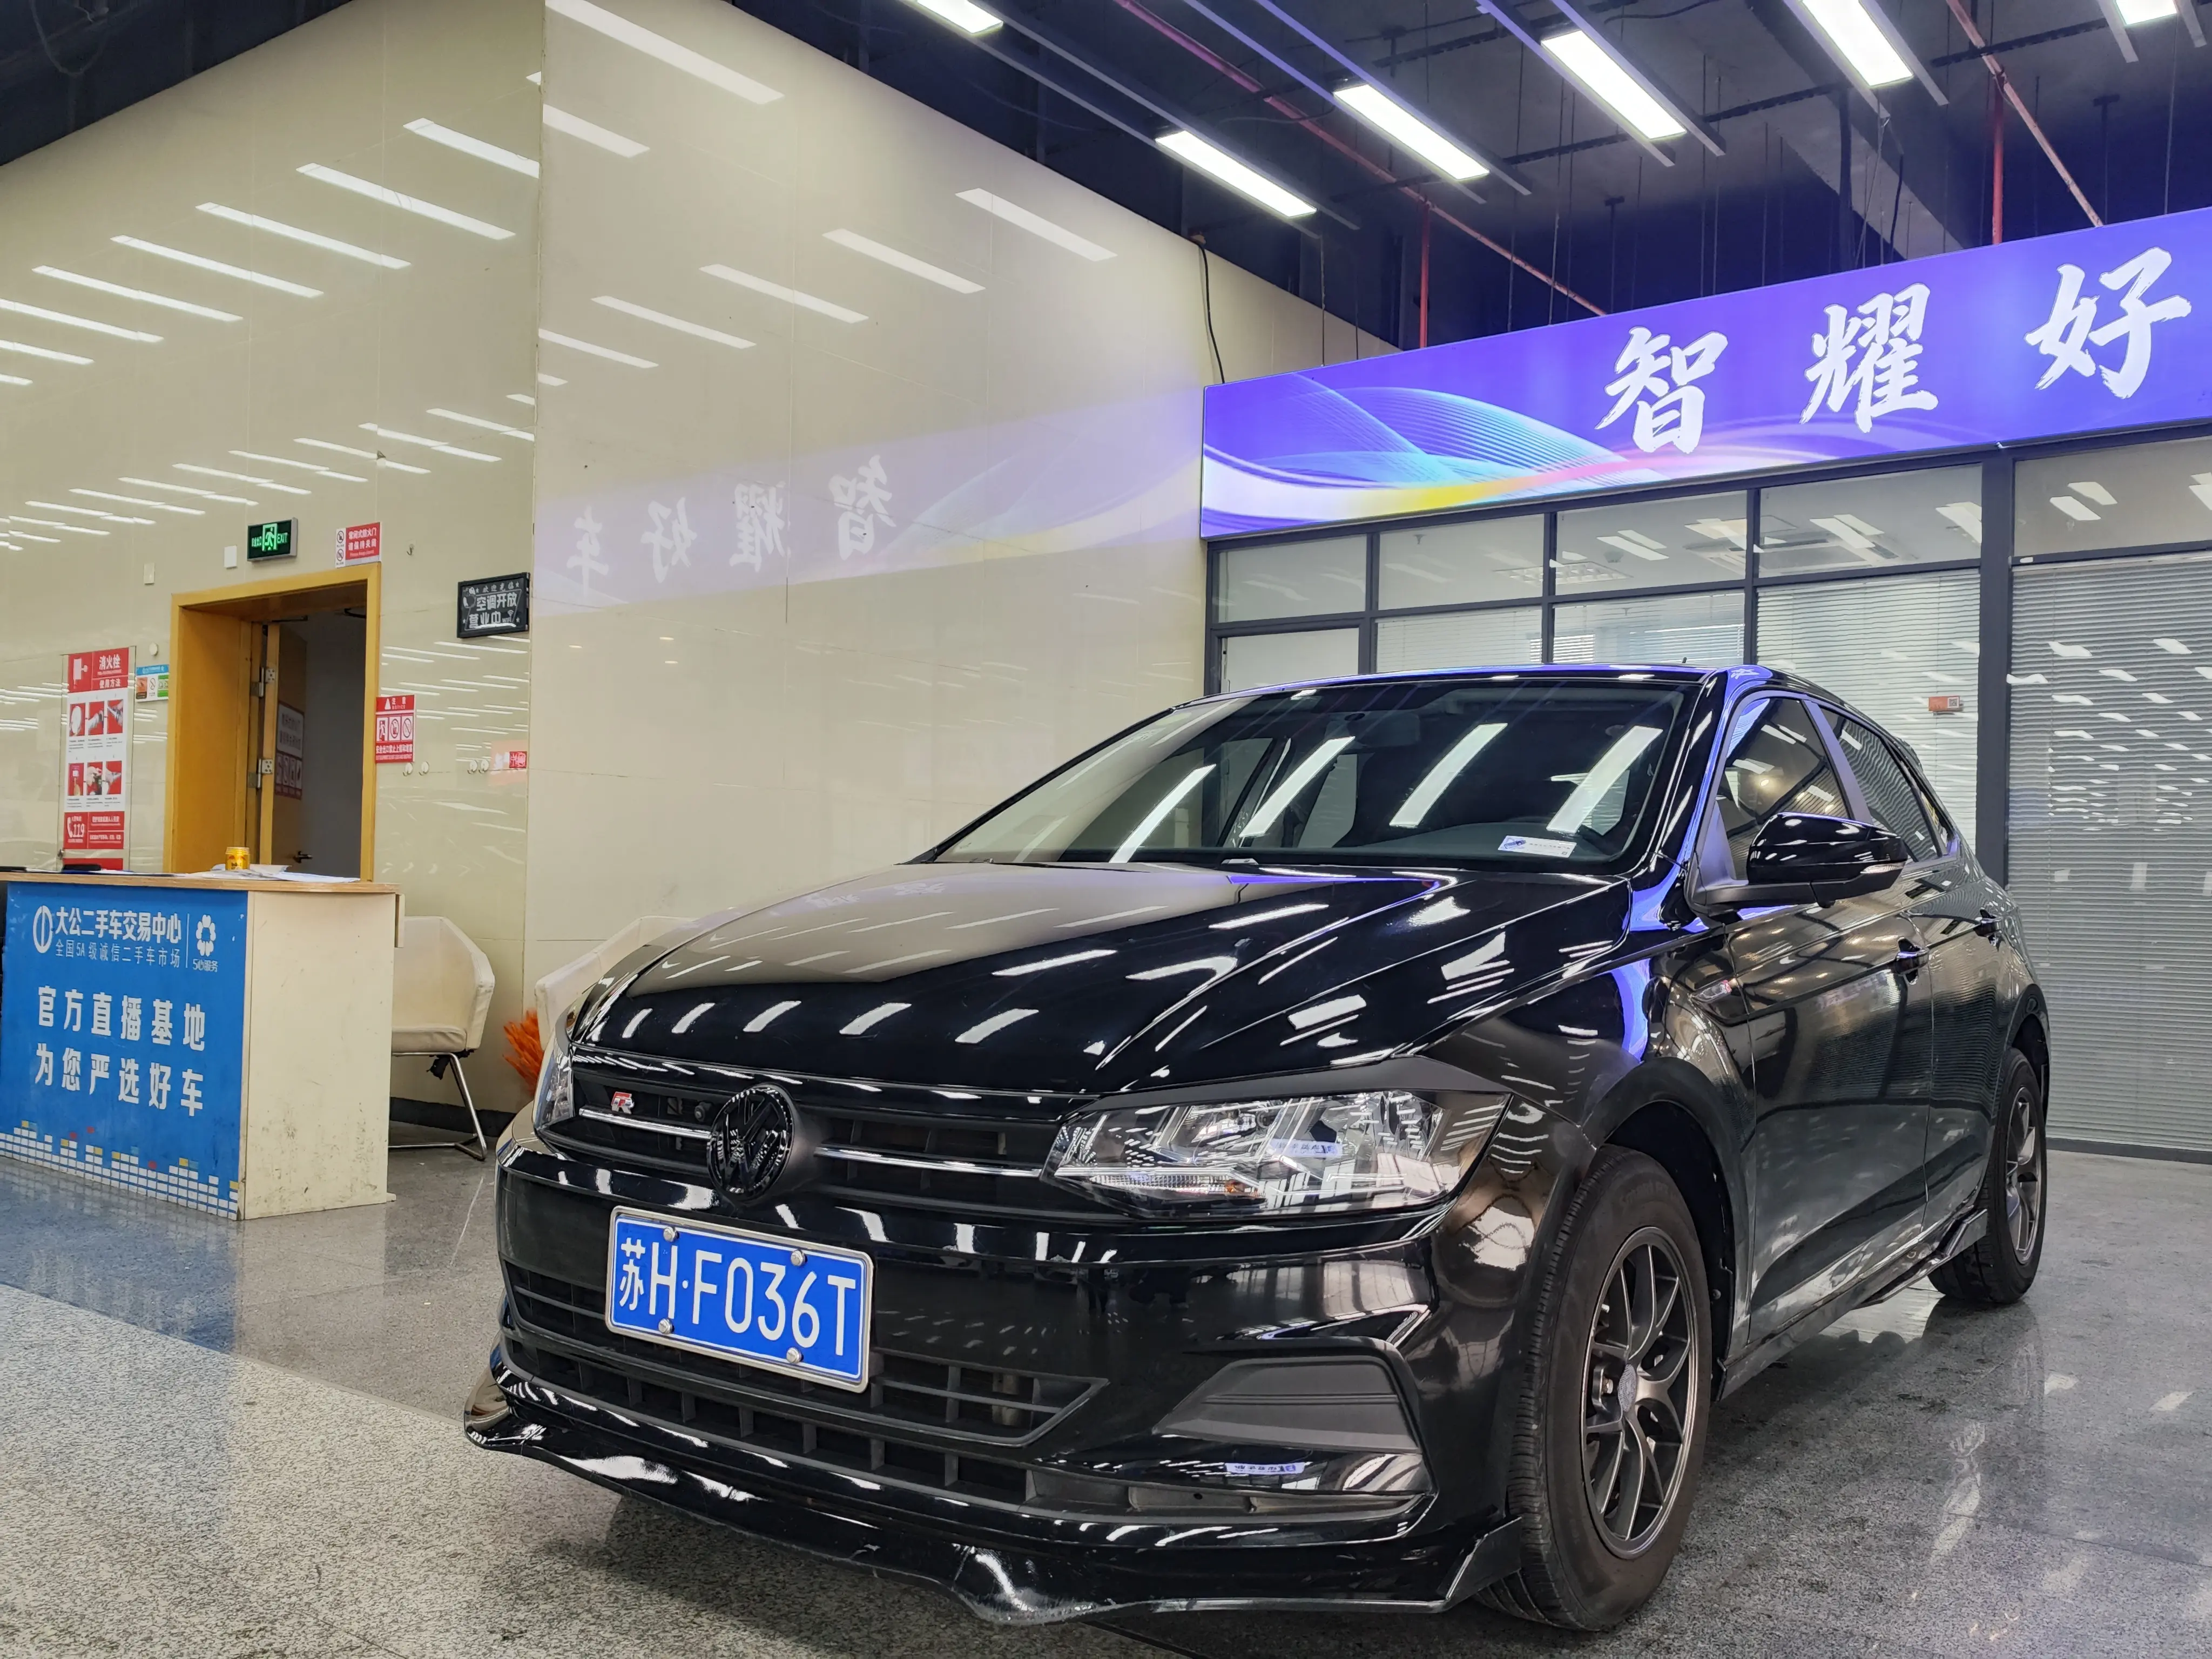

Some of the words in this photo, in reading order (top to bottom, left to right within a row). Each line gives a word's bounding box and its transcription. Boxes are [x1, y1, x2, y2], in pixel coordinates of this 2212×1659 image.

[1595, 246, 2192, 454] 智耀好
[277, 532, 288, 544] EXIT
[476, 592, 517, 611] 空调开放
[469, 611, 501, 629] 营业中
[99, 653, 120, 670] 消火栓
[99, 678, 120, 689] 使用方法
[72, 824, 85, 837] 119
[55, 906, 181, 943] 大公二手车交易中心
[55, 939, 180, 968] 全国5A级诚信二手车市场
[38, 986, 205, 1051] 官方直播基地
[34, 1042, 203, 1117] 为您严选好车
[619, 1237, 856, 1356] 苏H·F036T
